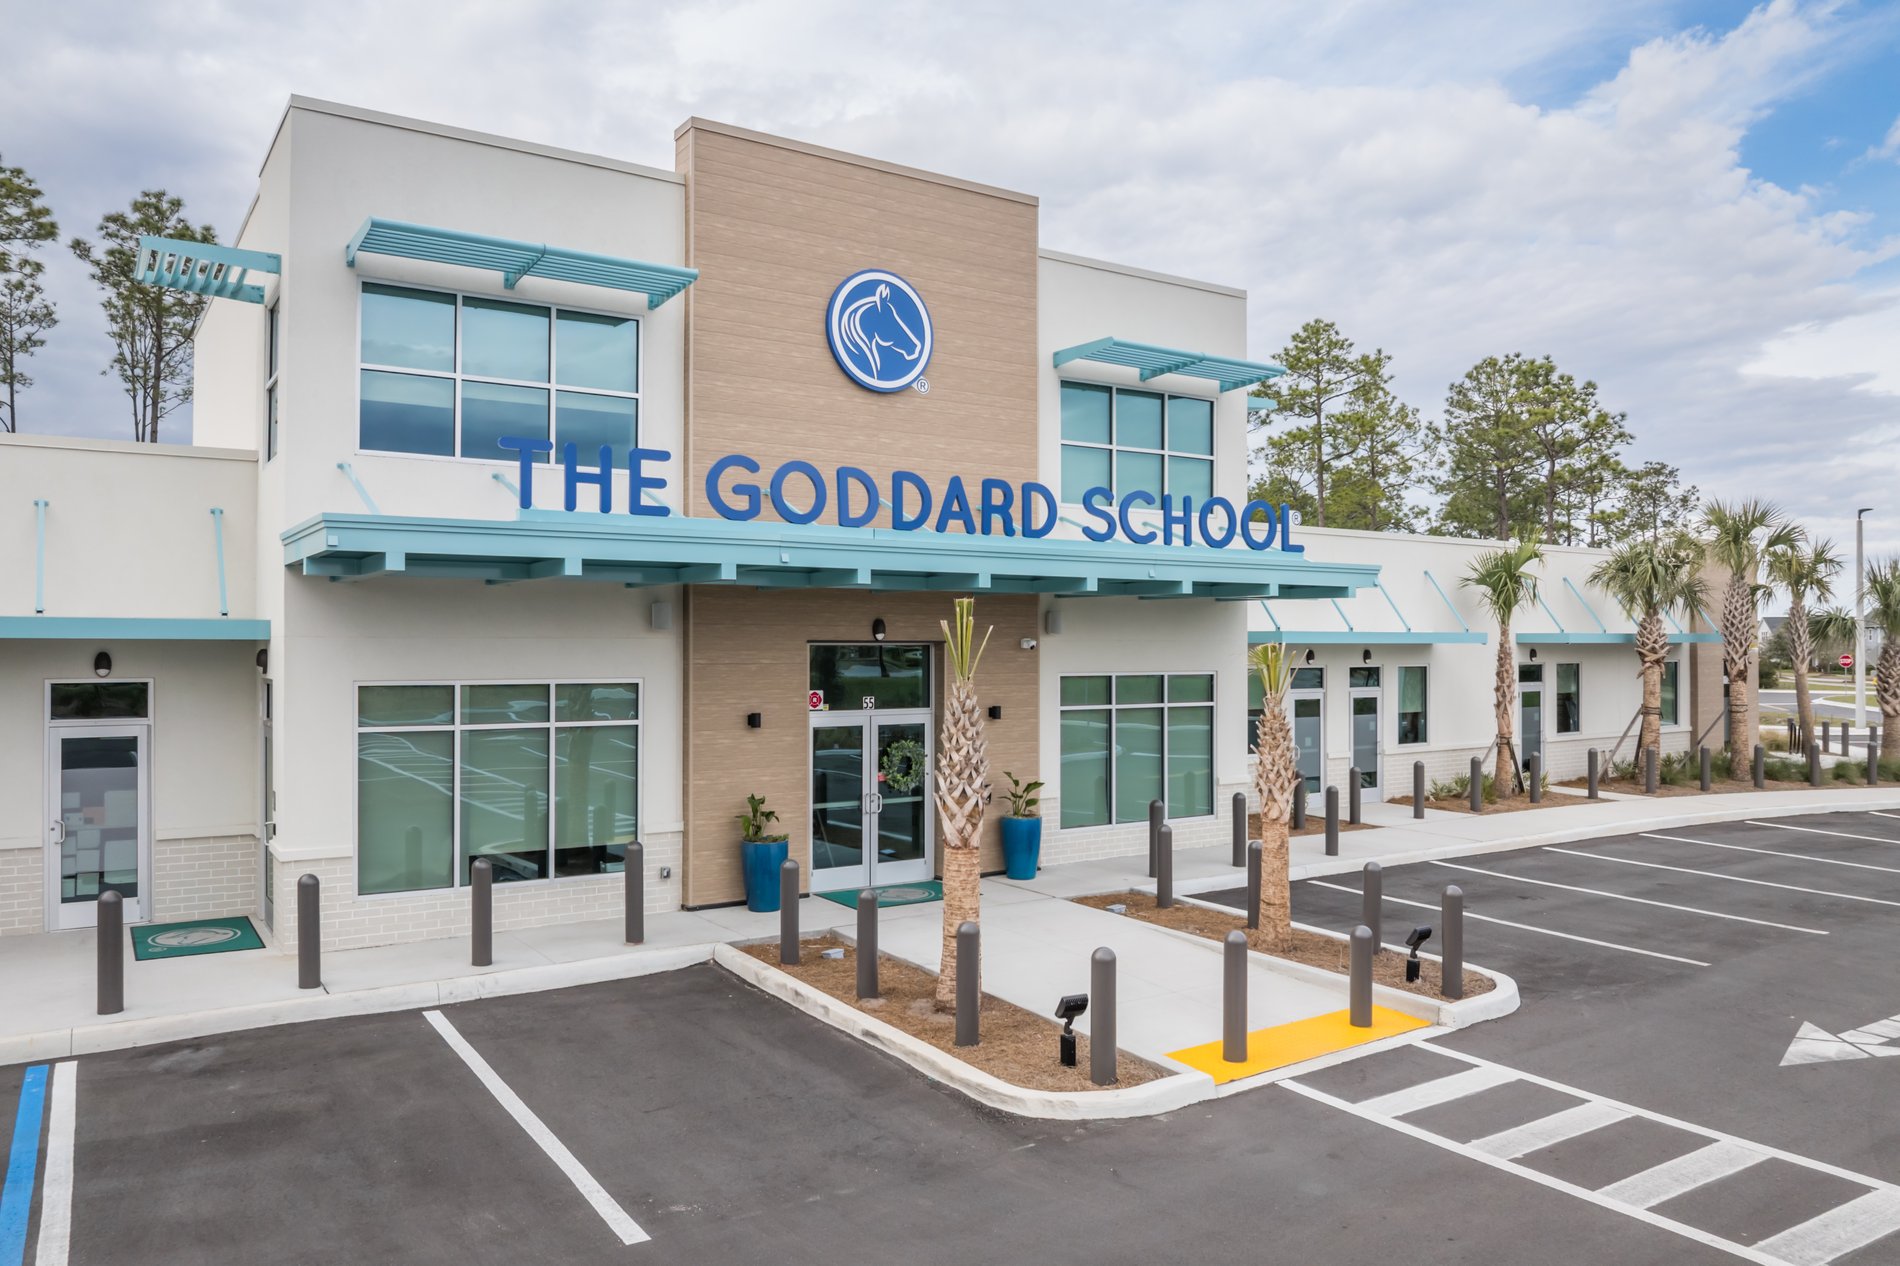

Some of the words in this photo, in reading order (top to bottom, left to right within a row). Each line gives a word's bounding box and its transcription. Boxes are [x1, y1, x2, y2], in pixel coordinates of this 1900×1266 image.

[497, 436, 671, 517] THE
[705, 454, 1058, 538] GODDARD
[1082, 486, 1305, 553] SCHOOL
[863, 697, 874, 709] 55
